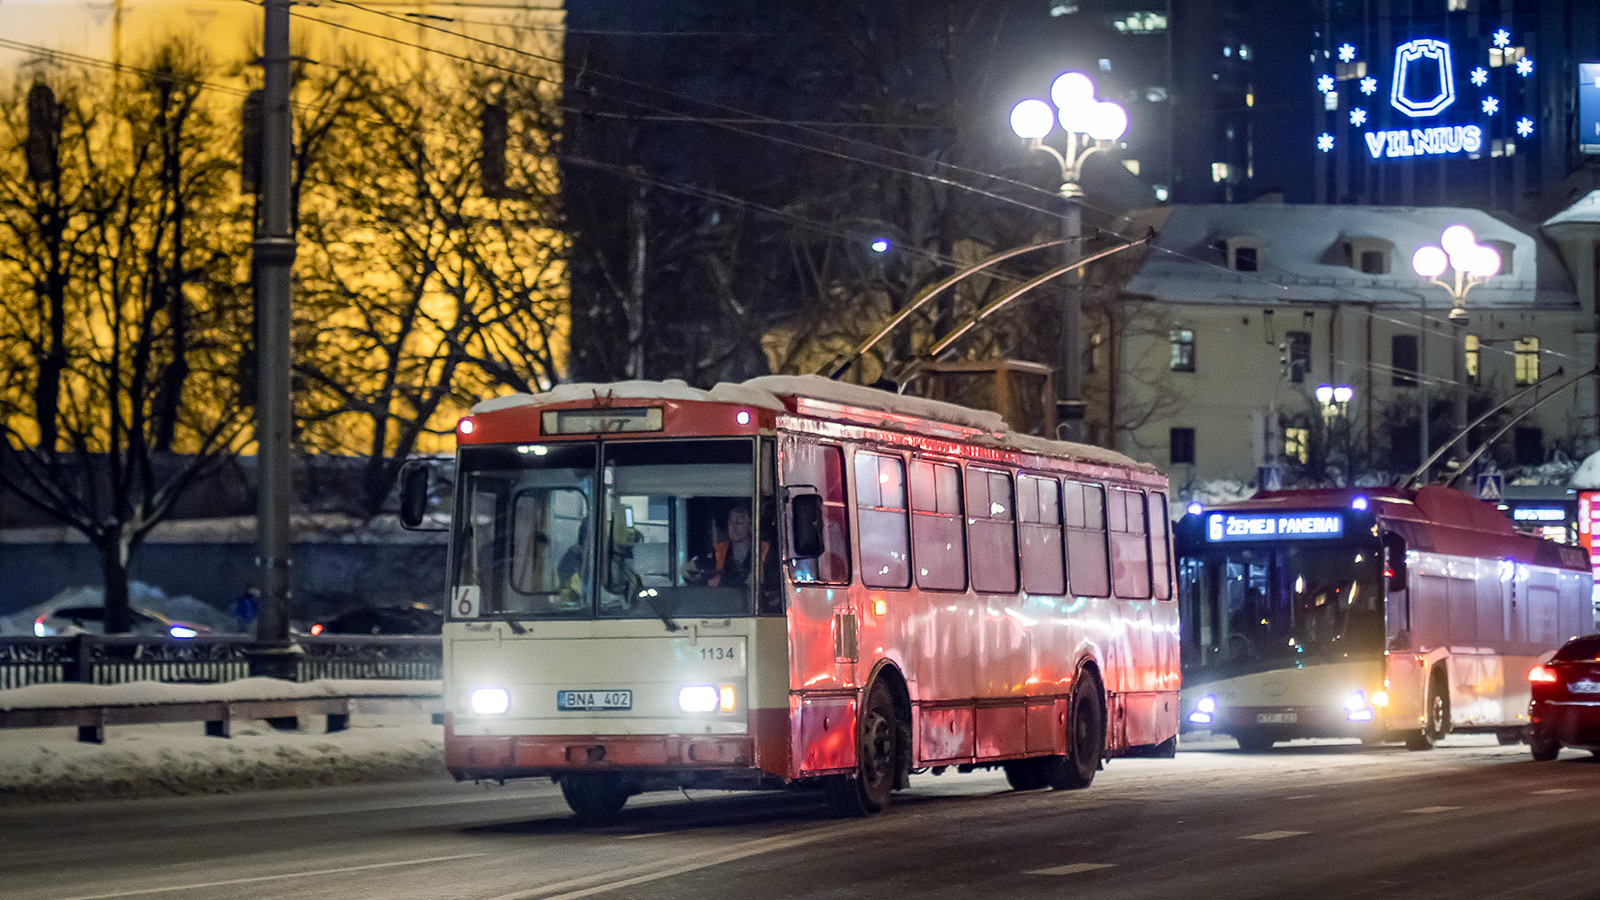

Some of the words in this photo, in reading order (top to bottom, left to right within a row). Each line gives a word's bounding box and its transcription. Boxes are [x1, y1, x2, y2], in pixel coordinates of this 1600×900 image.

[1364, 124, 1482, 159] VILNIUS
[1209, 514, 1223, 540] 6
[1278, 517, 1339, 534] PANERIAI
[458, 588, 472, 615] 6
[699, 646, 735, 660] 1134
[566, 692, 595, 706] BNA
[604, 692, 628, 706] 402
